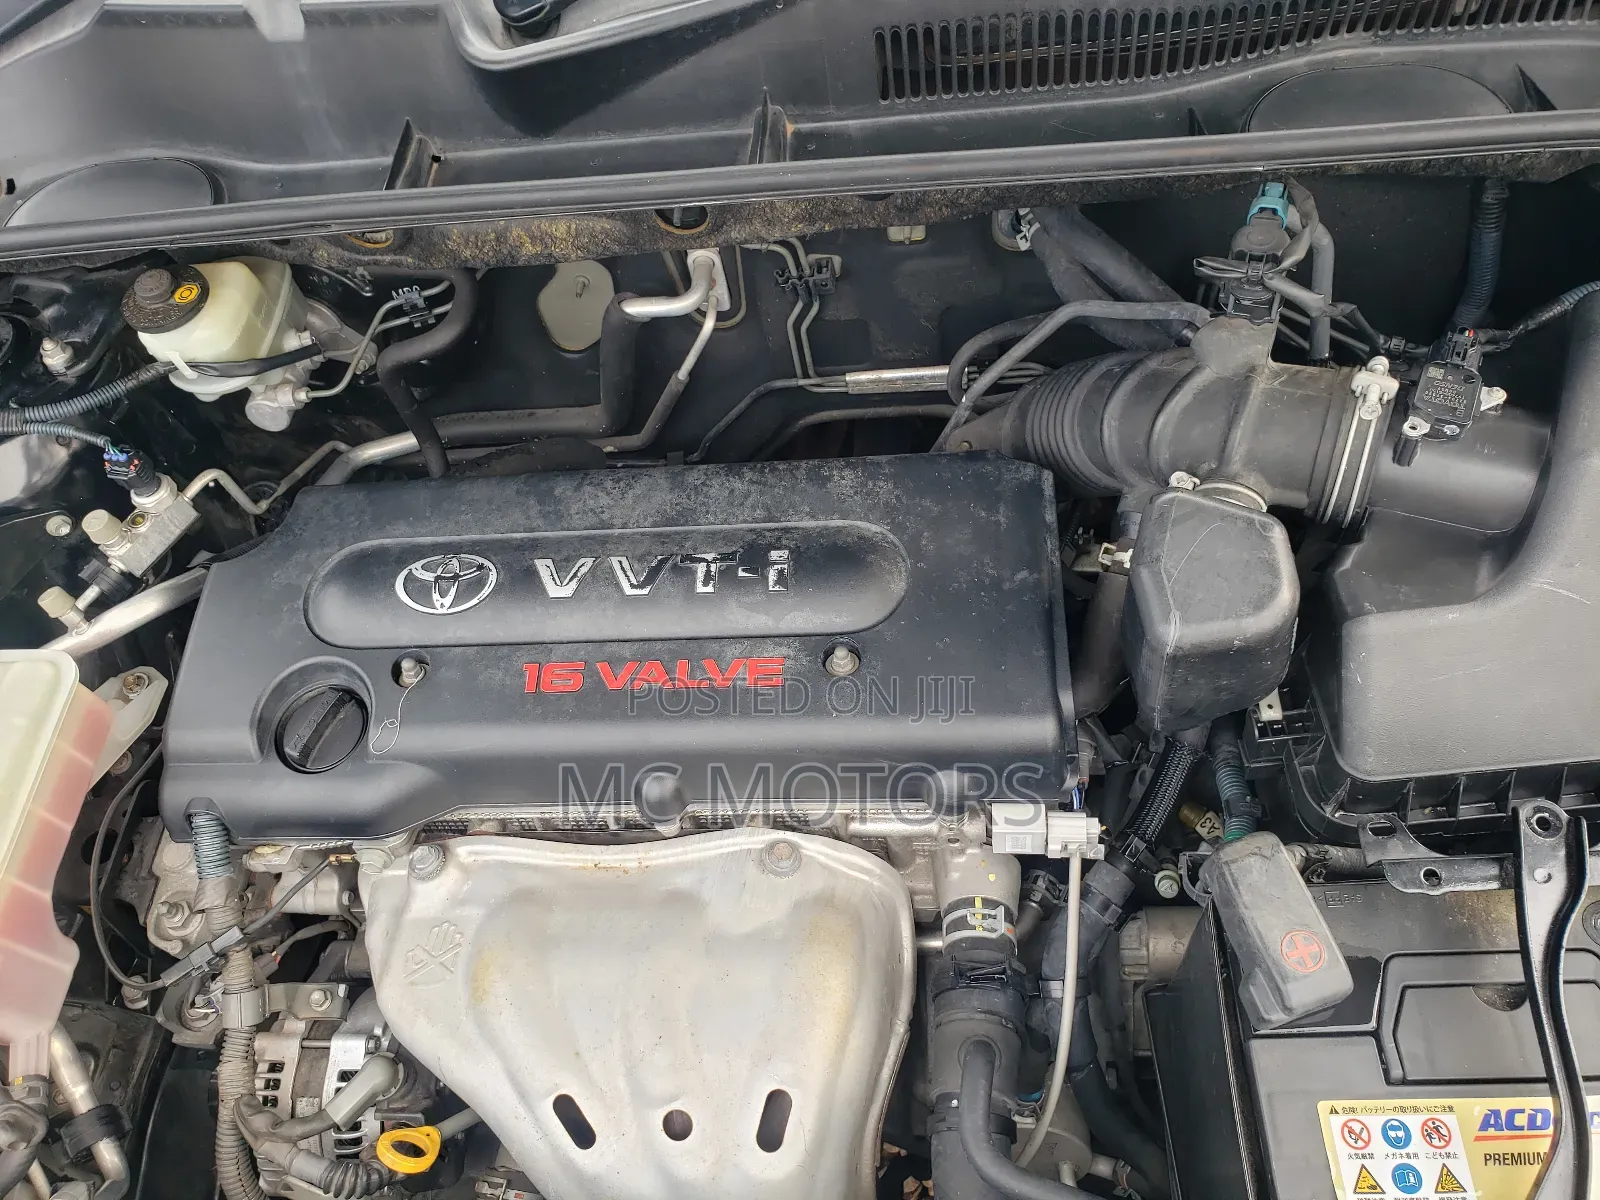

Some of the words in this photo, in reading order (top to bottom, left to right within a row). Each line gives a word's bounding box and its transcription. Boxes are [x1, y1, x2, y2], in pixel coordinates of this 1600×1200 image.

[1433, 380, 1465, 392] DENSO
[533, 549, 789, 599] VVT-i
[522, 661, 587, 693] 16
[595, 657, 786, 691] VALVE
[1200, 817, 1221, 835] A3
[1384, 1152, 1420, 1160] メガネ着用
[1425, 1152, 1459, 1160] こども禁止
